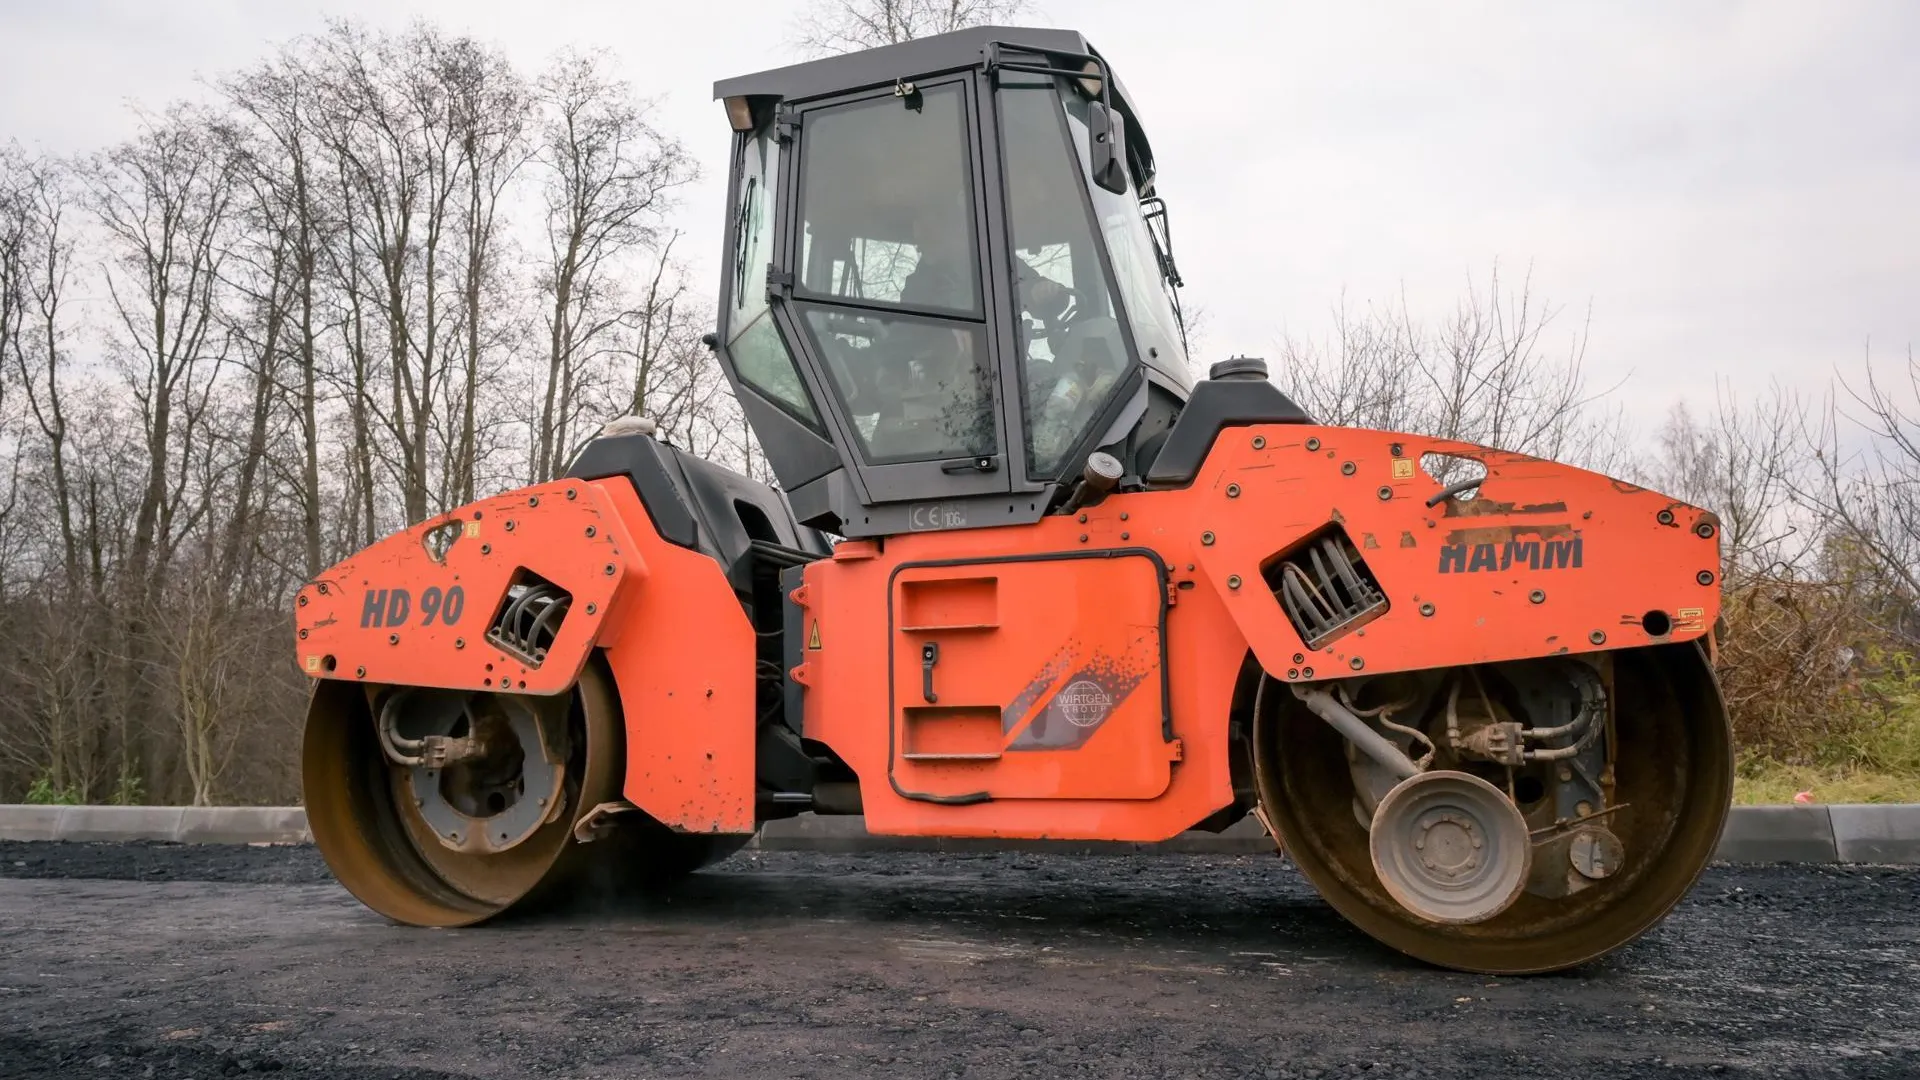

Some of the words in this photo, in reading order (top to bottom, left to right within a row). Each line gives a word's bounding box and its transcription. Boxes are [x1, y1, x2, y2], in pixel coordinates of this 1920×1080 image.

[914, 506, 939, 527] CE
[1438, 539, 1583, 573] HAMM
[360, 589, 411, 628] HD
[420, 585, 465, 626] 90
[1059, 693, 1110, 704] WIRTGEN
[1062, 705, 1106, 713] GROUP
